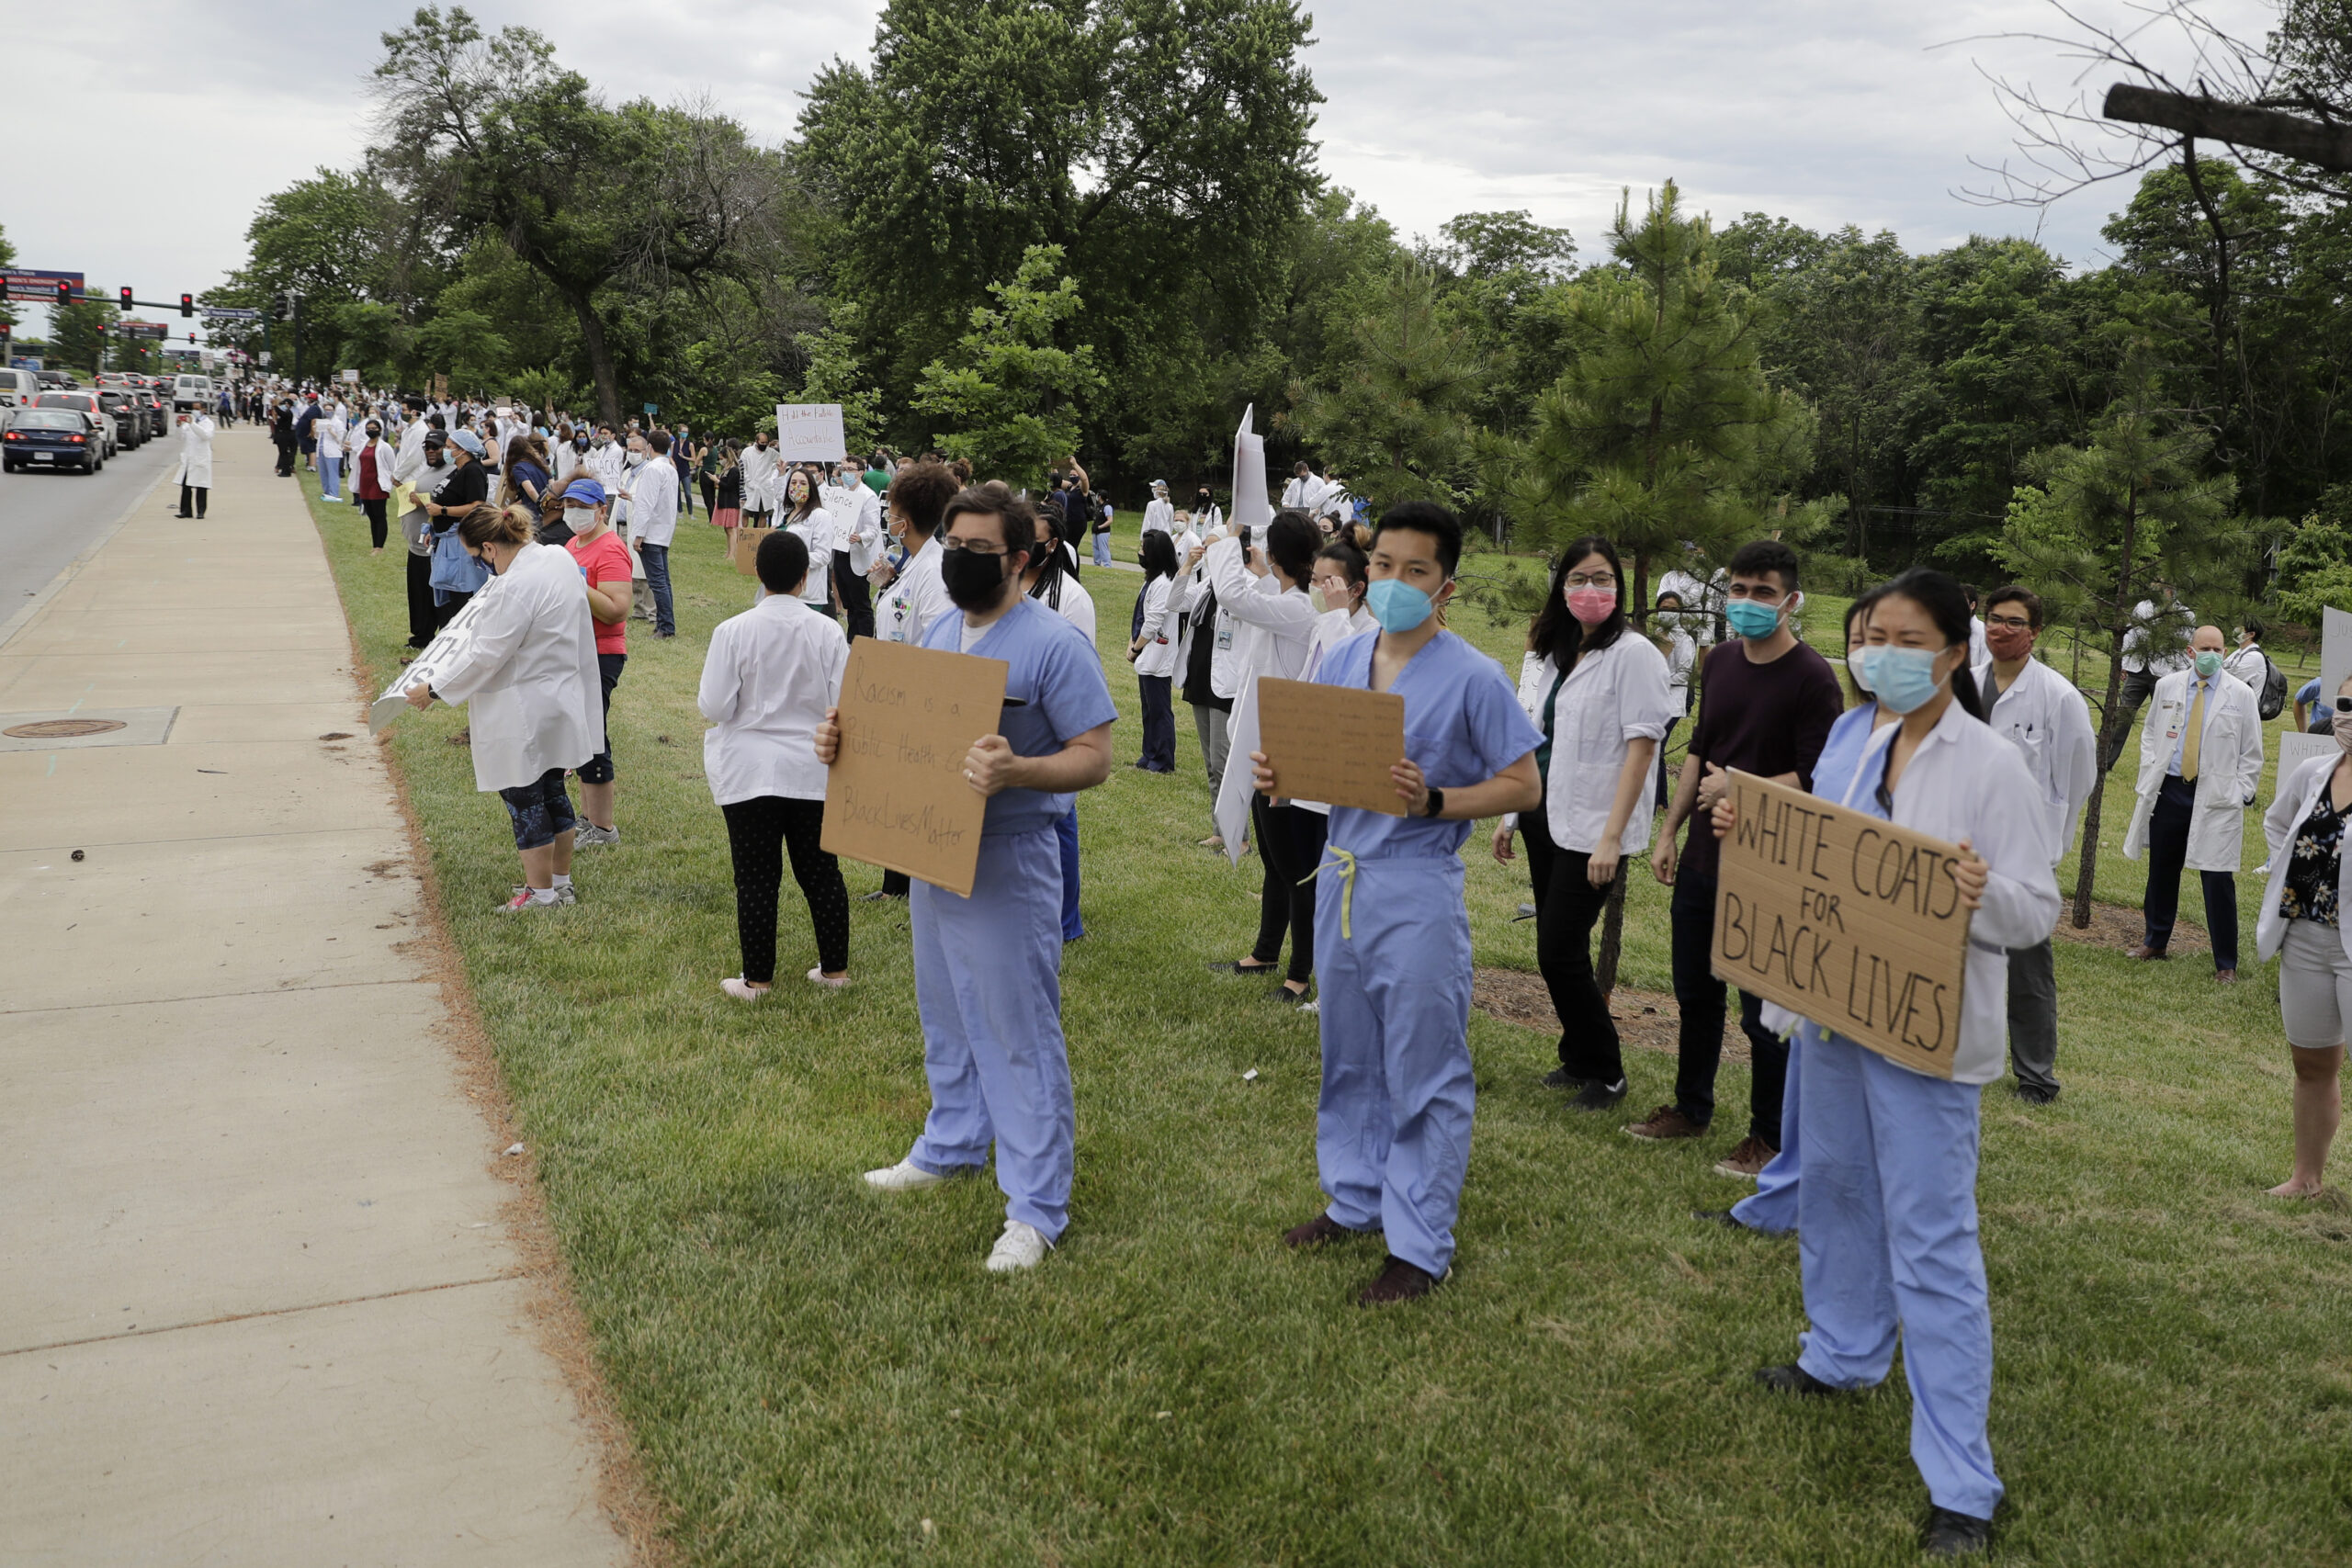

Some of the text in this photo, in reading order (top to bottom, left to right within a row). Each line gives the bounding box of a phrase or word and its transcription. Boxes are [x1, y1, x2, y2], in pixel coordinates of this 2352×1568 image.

[823, 488, 853, 508] Silence
[854, 656, 906, 706] Racism
[844, 716, 884, 758] Public
[899, 732, 935, 769] Health
[1736, 785, 1960, 919] WHITE COATS
[1801, 886, 1845, 934] FOR
[1722, 891, 1947, 1053] BLACK LIVES
